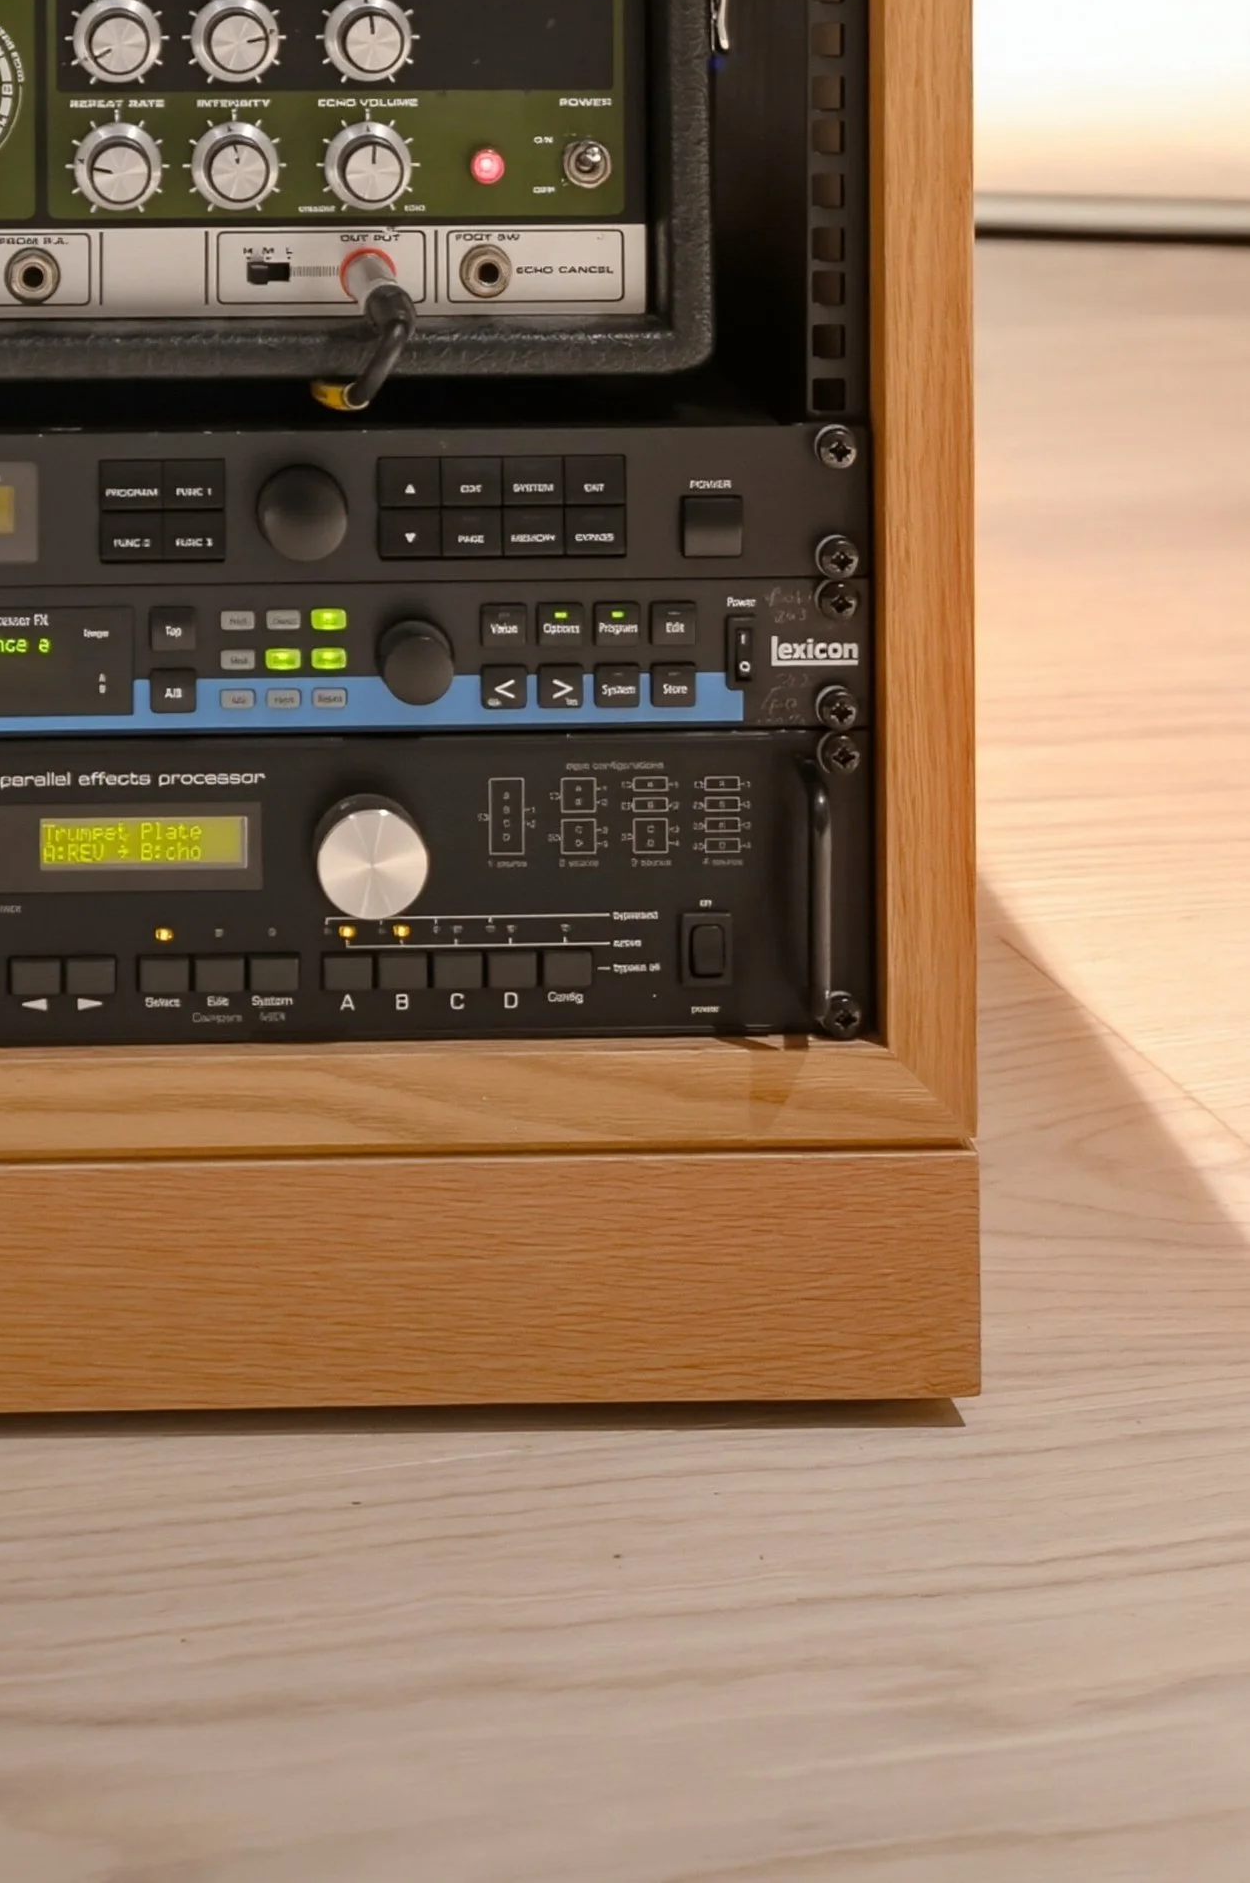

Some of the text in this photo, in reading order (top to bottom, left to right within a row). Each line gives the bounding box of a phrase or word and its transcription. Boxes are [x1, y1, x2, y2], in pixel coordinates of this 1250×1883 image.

[128, 99, 165, 108] RATE
[196, 99, 270, 108] INTENSITY
[318, 98, 419, 107] ECHO VOLUME
[559, 97, 613, 106] POWER
[340, 234, 366, 243] OUT
[455, 233, 492, 242] FOOT
[516, 265, 614, 274] ECHO CANCEL
[513, 483, 554, 493] SYSTEM
[689, 479, 732, 489] POWER
[176, 487, 212, 496] FUNC 1
[113, 538, 141, 548] FUNC
[458, 535, 485, 544] PAGE
[33, 614, 49, 626] FX
[165, 626, 183, 638] Tap
[543, 623, 580, 635] Options
[598, 622, 638, 636] Program
[666, 621, 685, 634] Edit
[38, 638, 51, 654] a
[164, 688, 183, 699] A/B
[601, 683, 636, 697] System
[663, 683, 688, 695] Store
[0, 771, 71, 789] parallel
[78, 772, 152, 786] effects
[158, 771, 267, 788] processor
[42, 821, 202, 842] Trumpet Plate
[42, 842, 104, 863] A:REV
[145, 996, 181, 1008] Select
[207, 996, 230, 1007] Edit
[251, 996, 294, 1008] System
[340, 994, 355, 1011] A
[395, 994, 409, 1010] B
[449, 993, 465, 1010] C
[504, 992, 519, 1009] D
[547, 991, 584, 1005] Config
